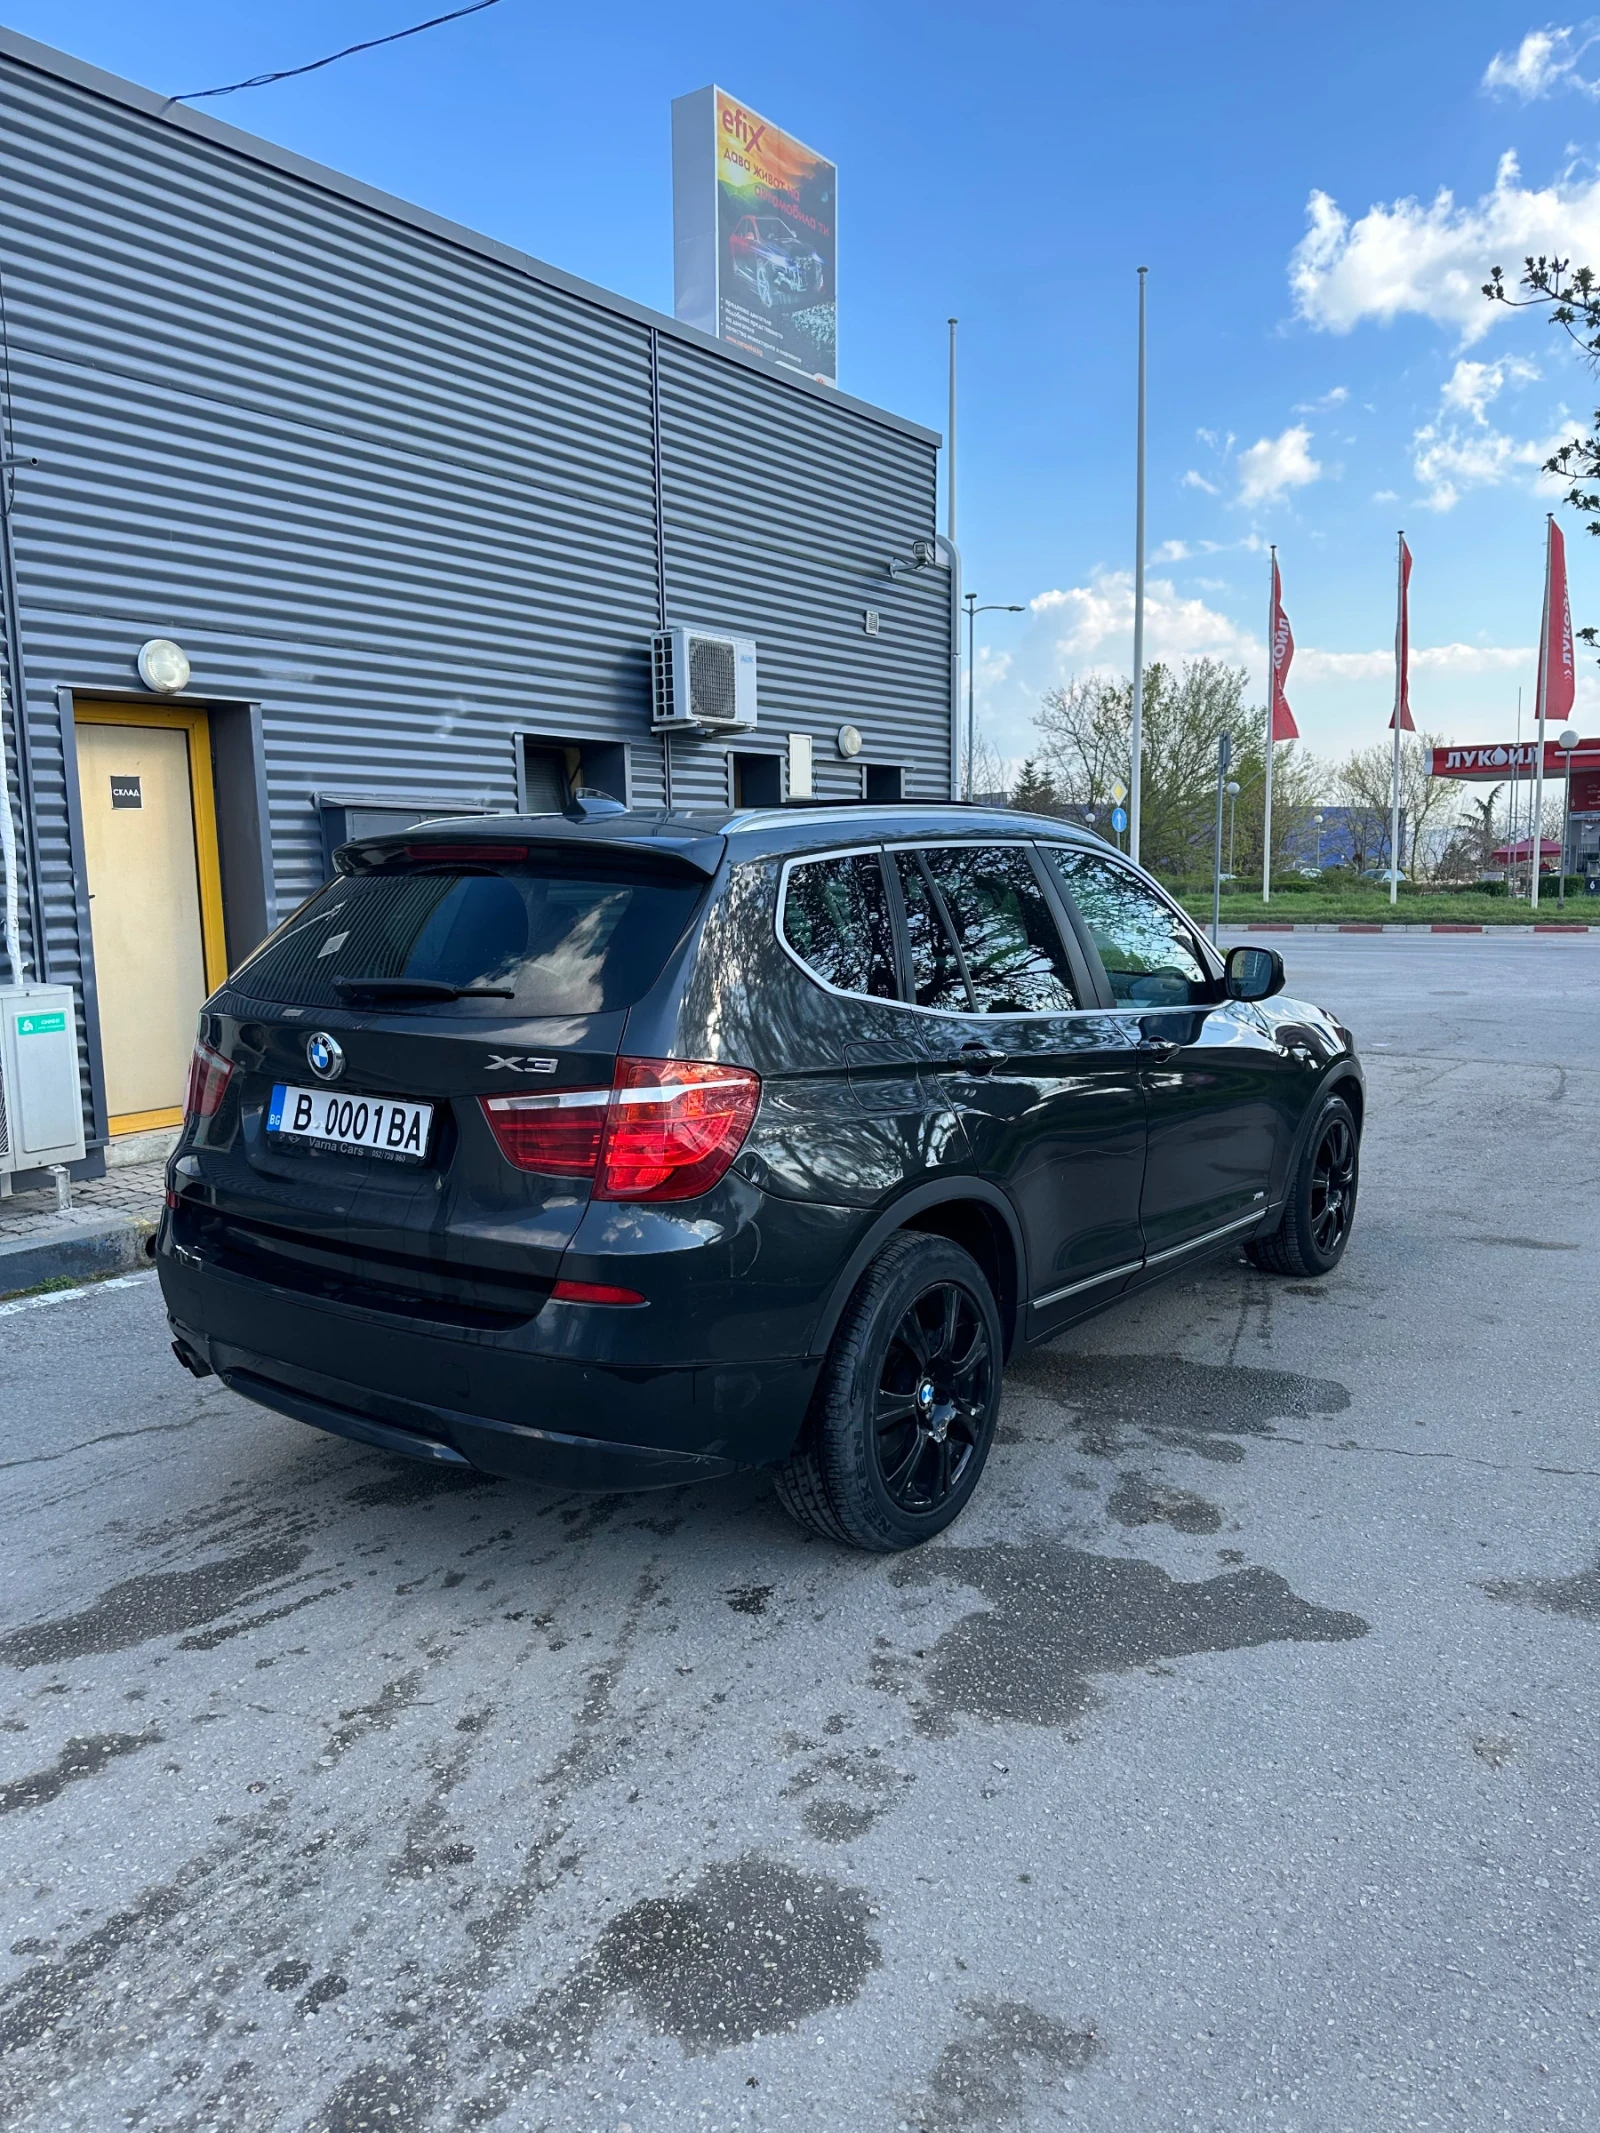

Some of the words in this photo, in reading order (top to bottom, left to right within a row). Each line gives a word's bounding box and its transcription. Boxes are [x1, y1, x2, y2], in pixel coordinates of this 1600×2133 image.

[753, 164, 785, 190] живот
[787, 185, 800, 201] на
[755, 185, 816, 230] автомобила
[818, 222, 829, 236] ти
[113, 788, 140, 797] СКЛАД
[1589, 880, 1596, 890] 6
[483, 1054, 559, 1074] X3
[269, 1114, 281, 1126] BG
[309, 1137, 337, 1152] Varna
[340, 1142, 364, 1156] Cars
